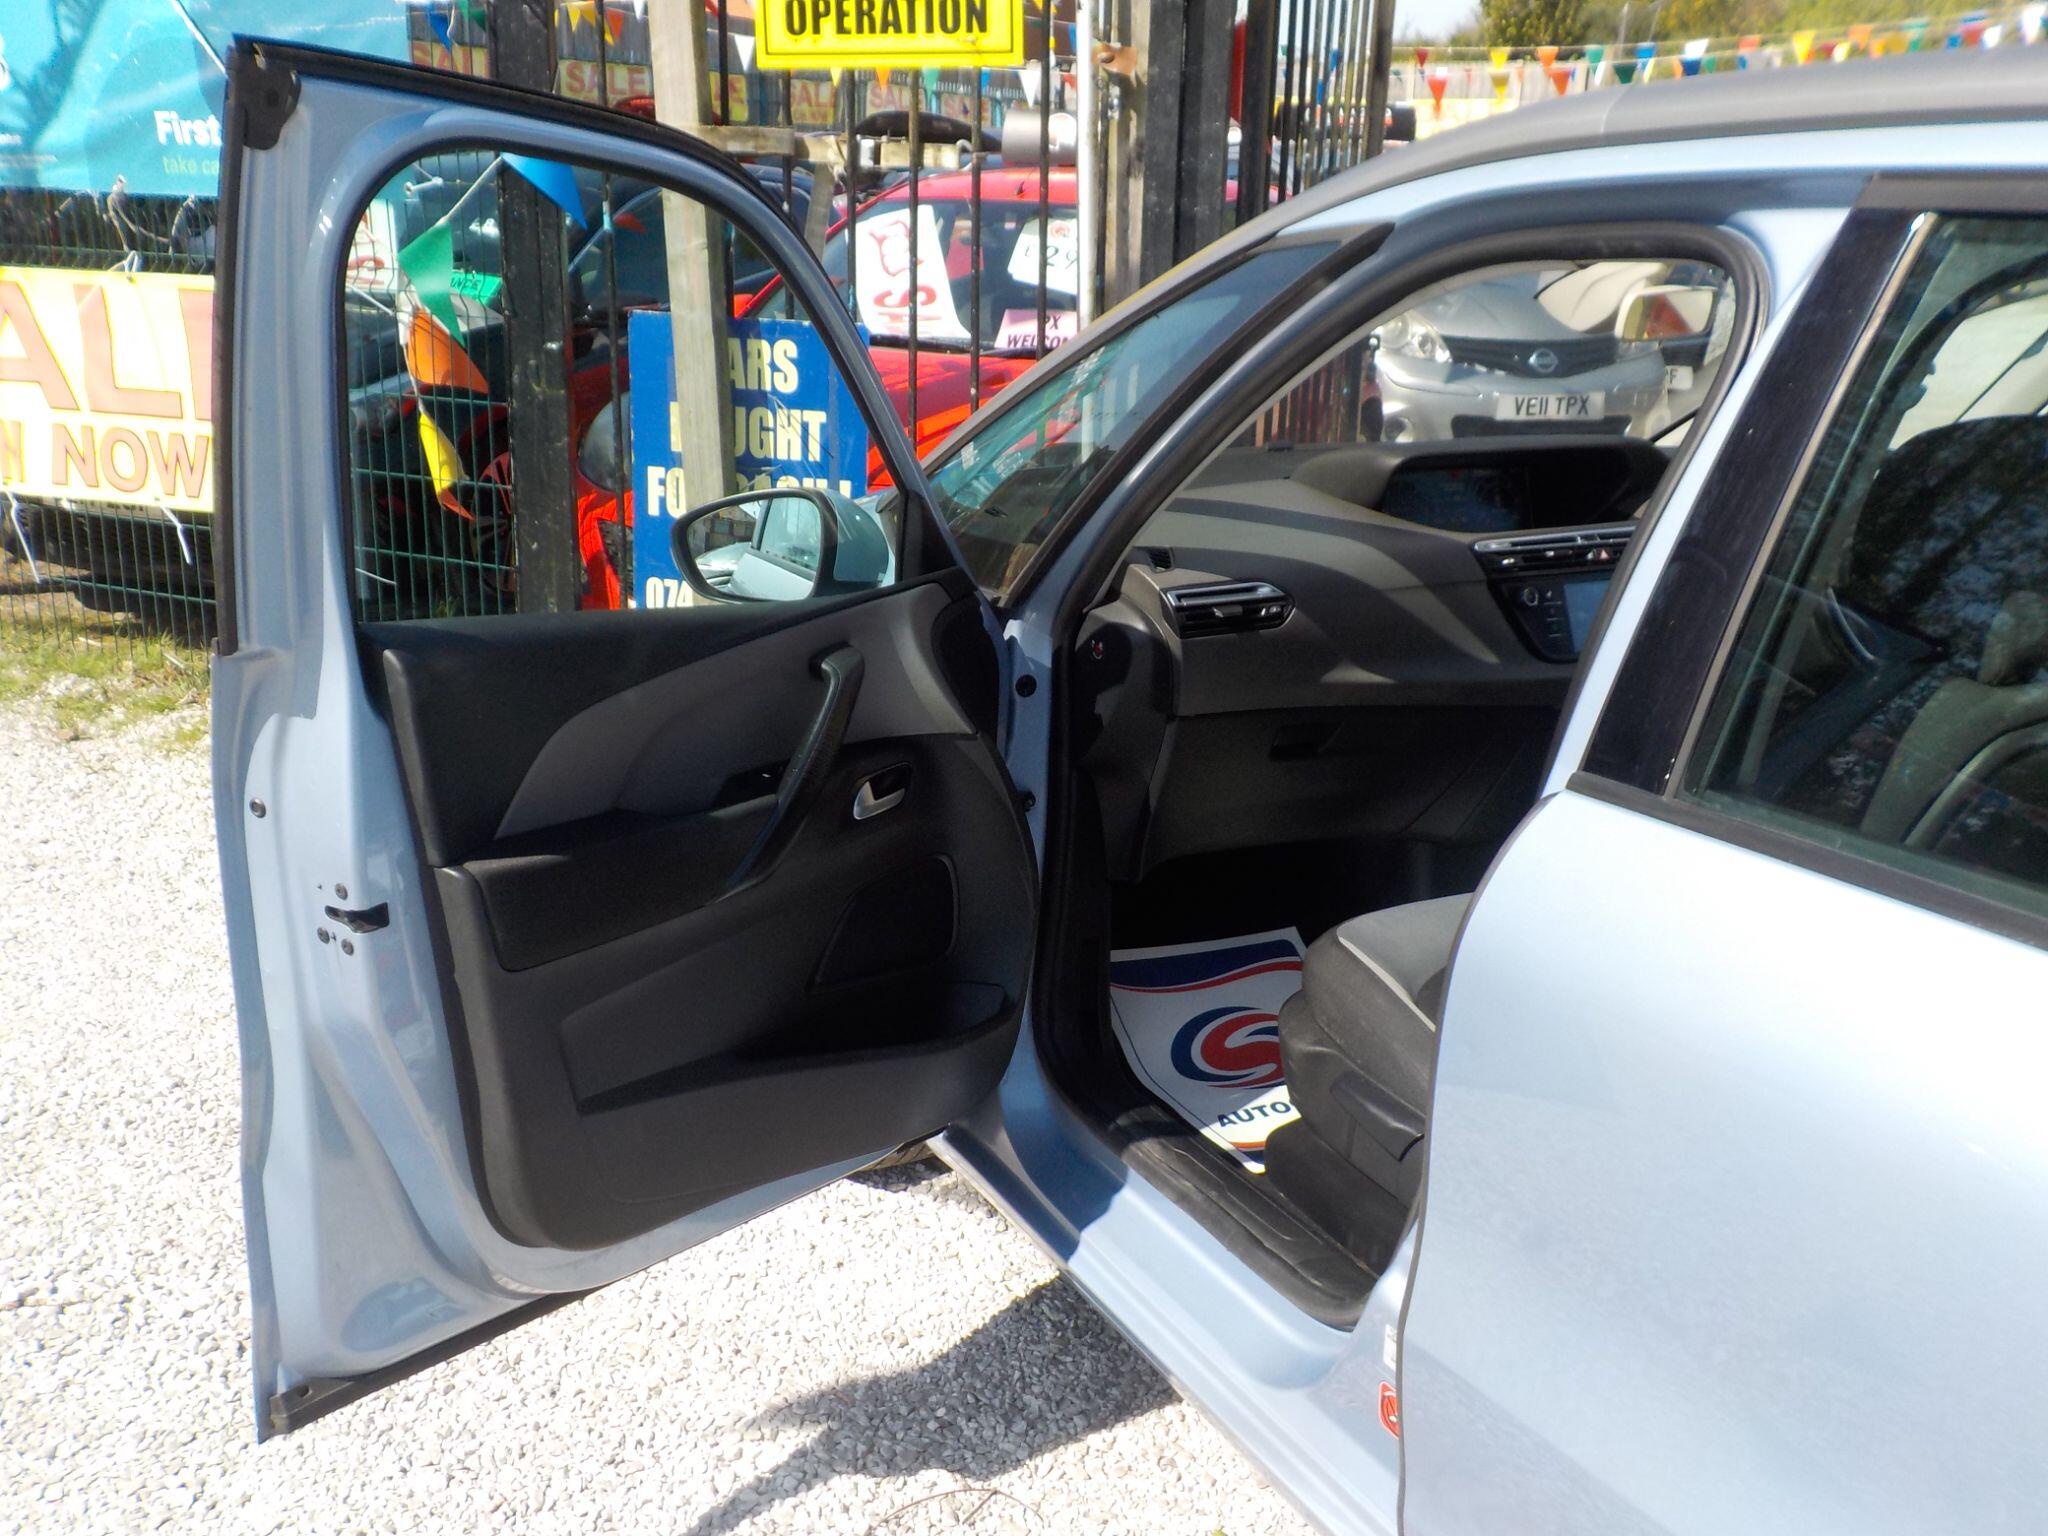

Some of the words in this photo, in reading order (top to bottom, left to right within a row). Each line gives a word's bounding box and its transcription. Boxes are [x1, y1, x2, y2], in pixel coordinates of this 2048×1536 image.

[785, 0, 988, 36] OPERATION
[153, 110, 223, 146] First
[162, 156, 196, 175] take
[727, 338, 799, 394] ARS
[1556, 395, 1590, 417] TPX
[52, 423, 210, 498] NOW
[647, 466, 688, 519] FO
[1217, 1101, 1292, 1127] AUTO
